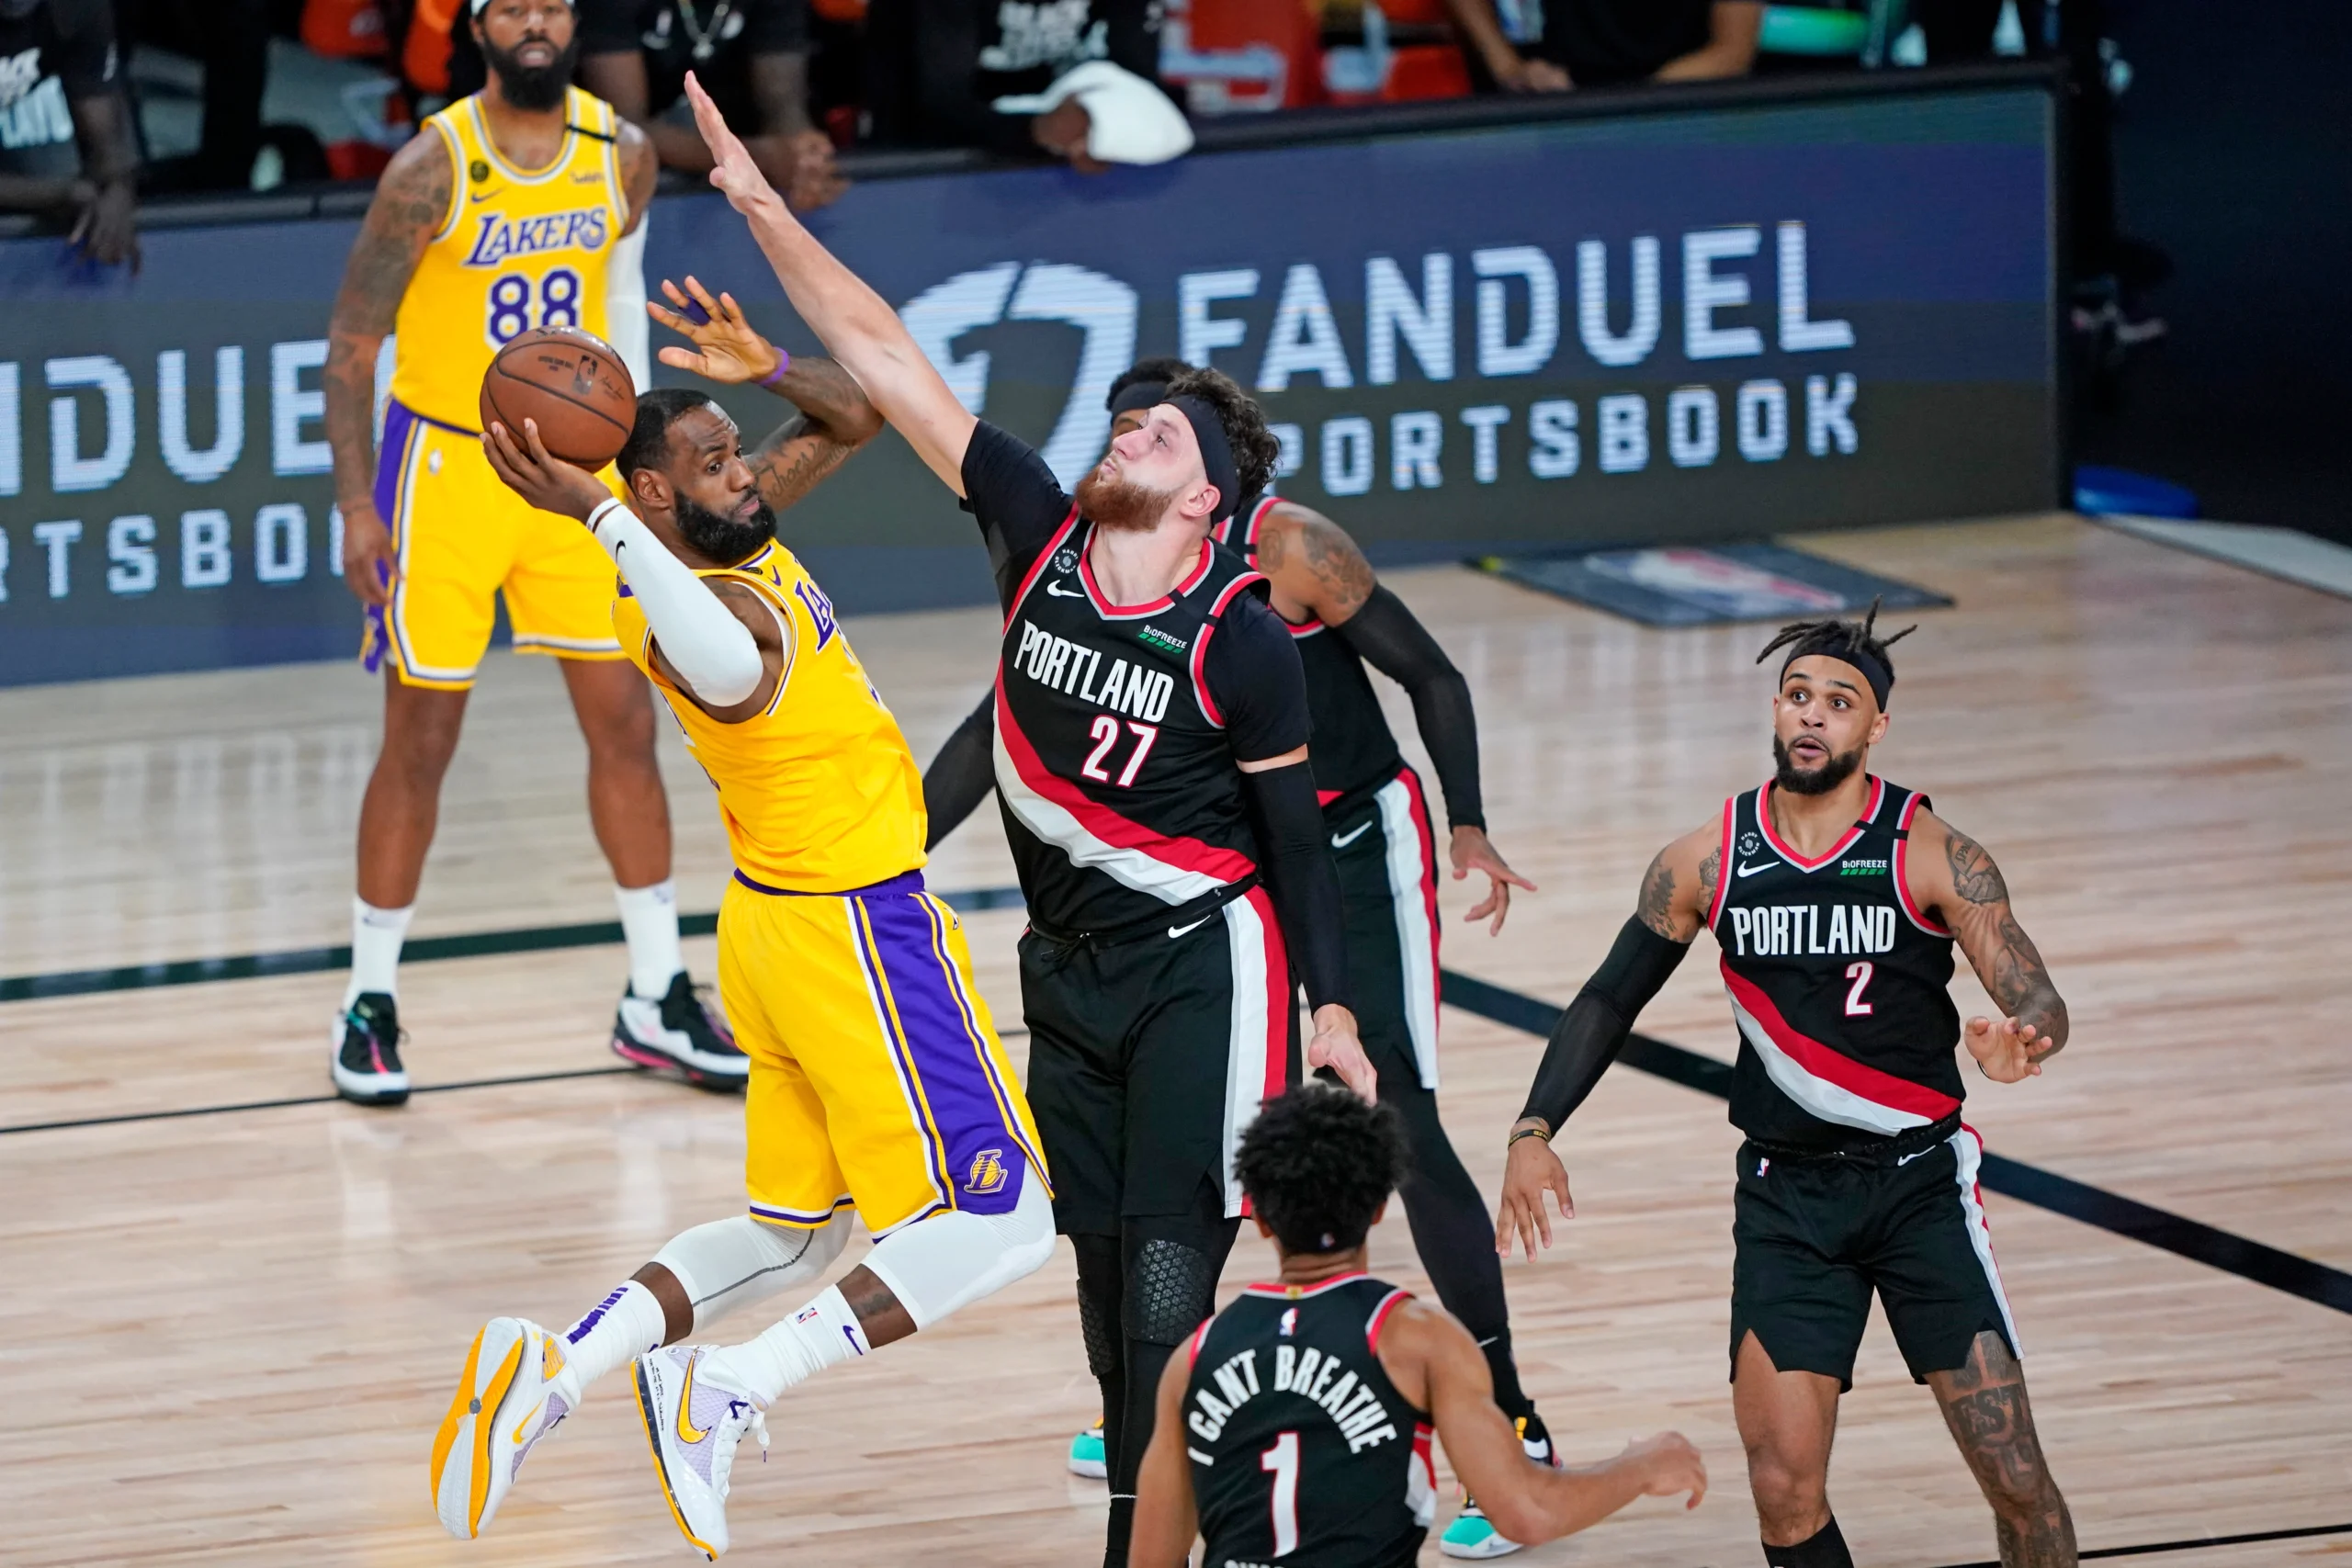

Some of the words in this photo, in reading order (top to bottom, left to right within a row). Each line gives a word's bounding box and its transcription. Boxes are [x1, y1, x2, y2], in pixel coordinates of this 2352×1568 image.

[462, 207, 608, 268] LAKERS
[485, 266, 582, 353] 88
[1177, 220, 1857, 393] FANDUEL
[0, 333, 395, 498] DUE
[1265, 371, 1860, 498] PORTSBOOK
[0, 501, 345, 604] TSBO
[1013, 619, 1175, 725] PORTLAND
[1080, 714, 1159, 789] 27
[1727, 905, 1895, 956] PORTLAND
[1845, 961, 1874, 1017] 2
[1273, 1344, 1397, 1454] BREATHE
[1261, 1431, 1300, 1558] 1
